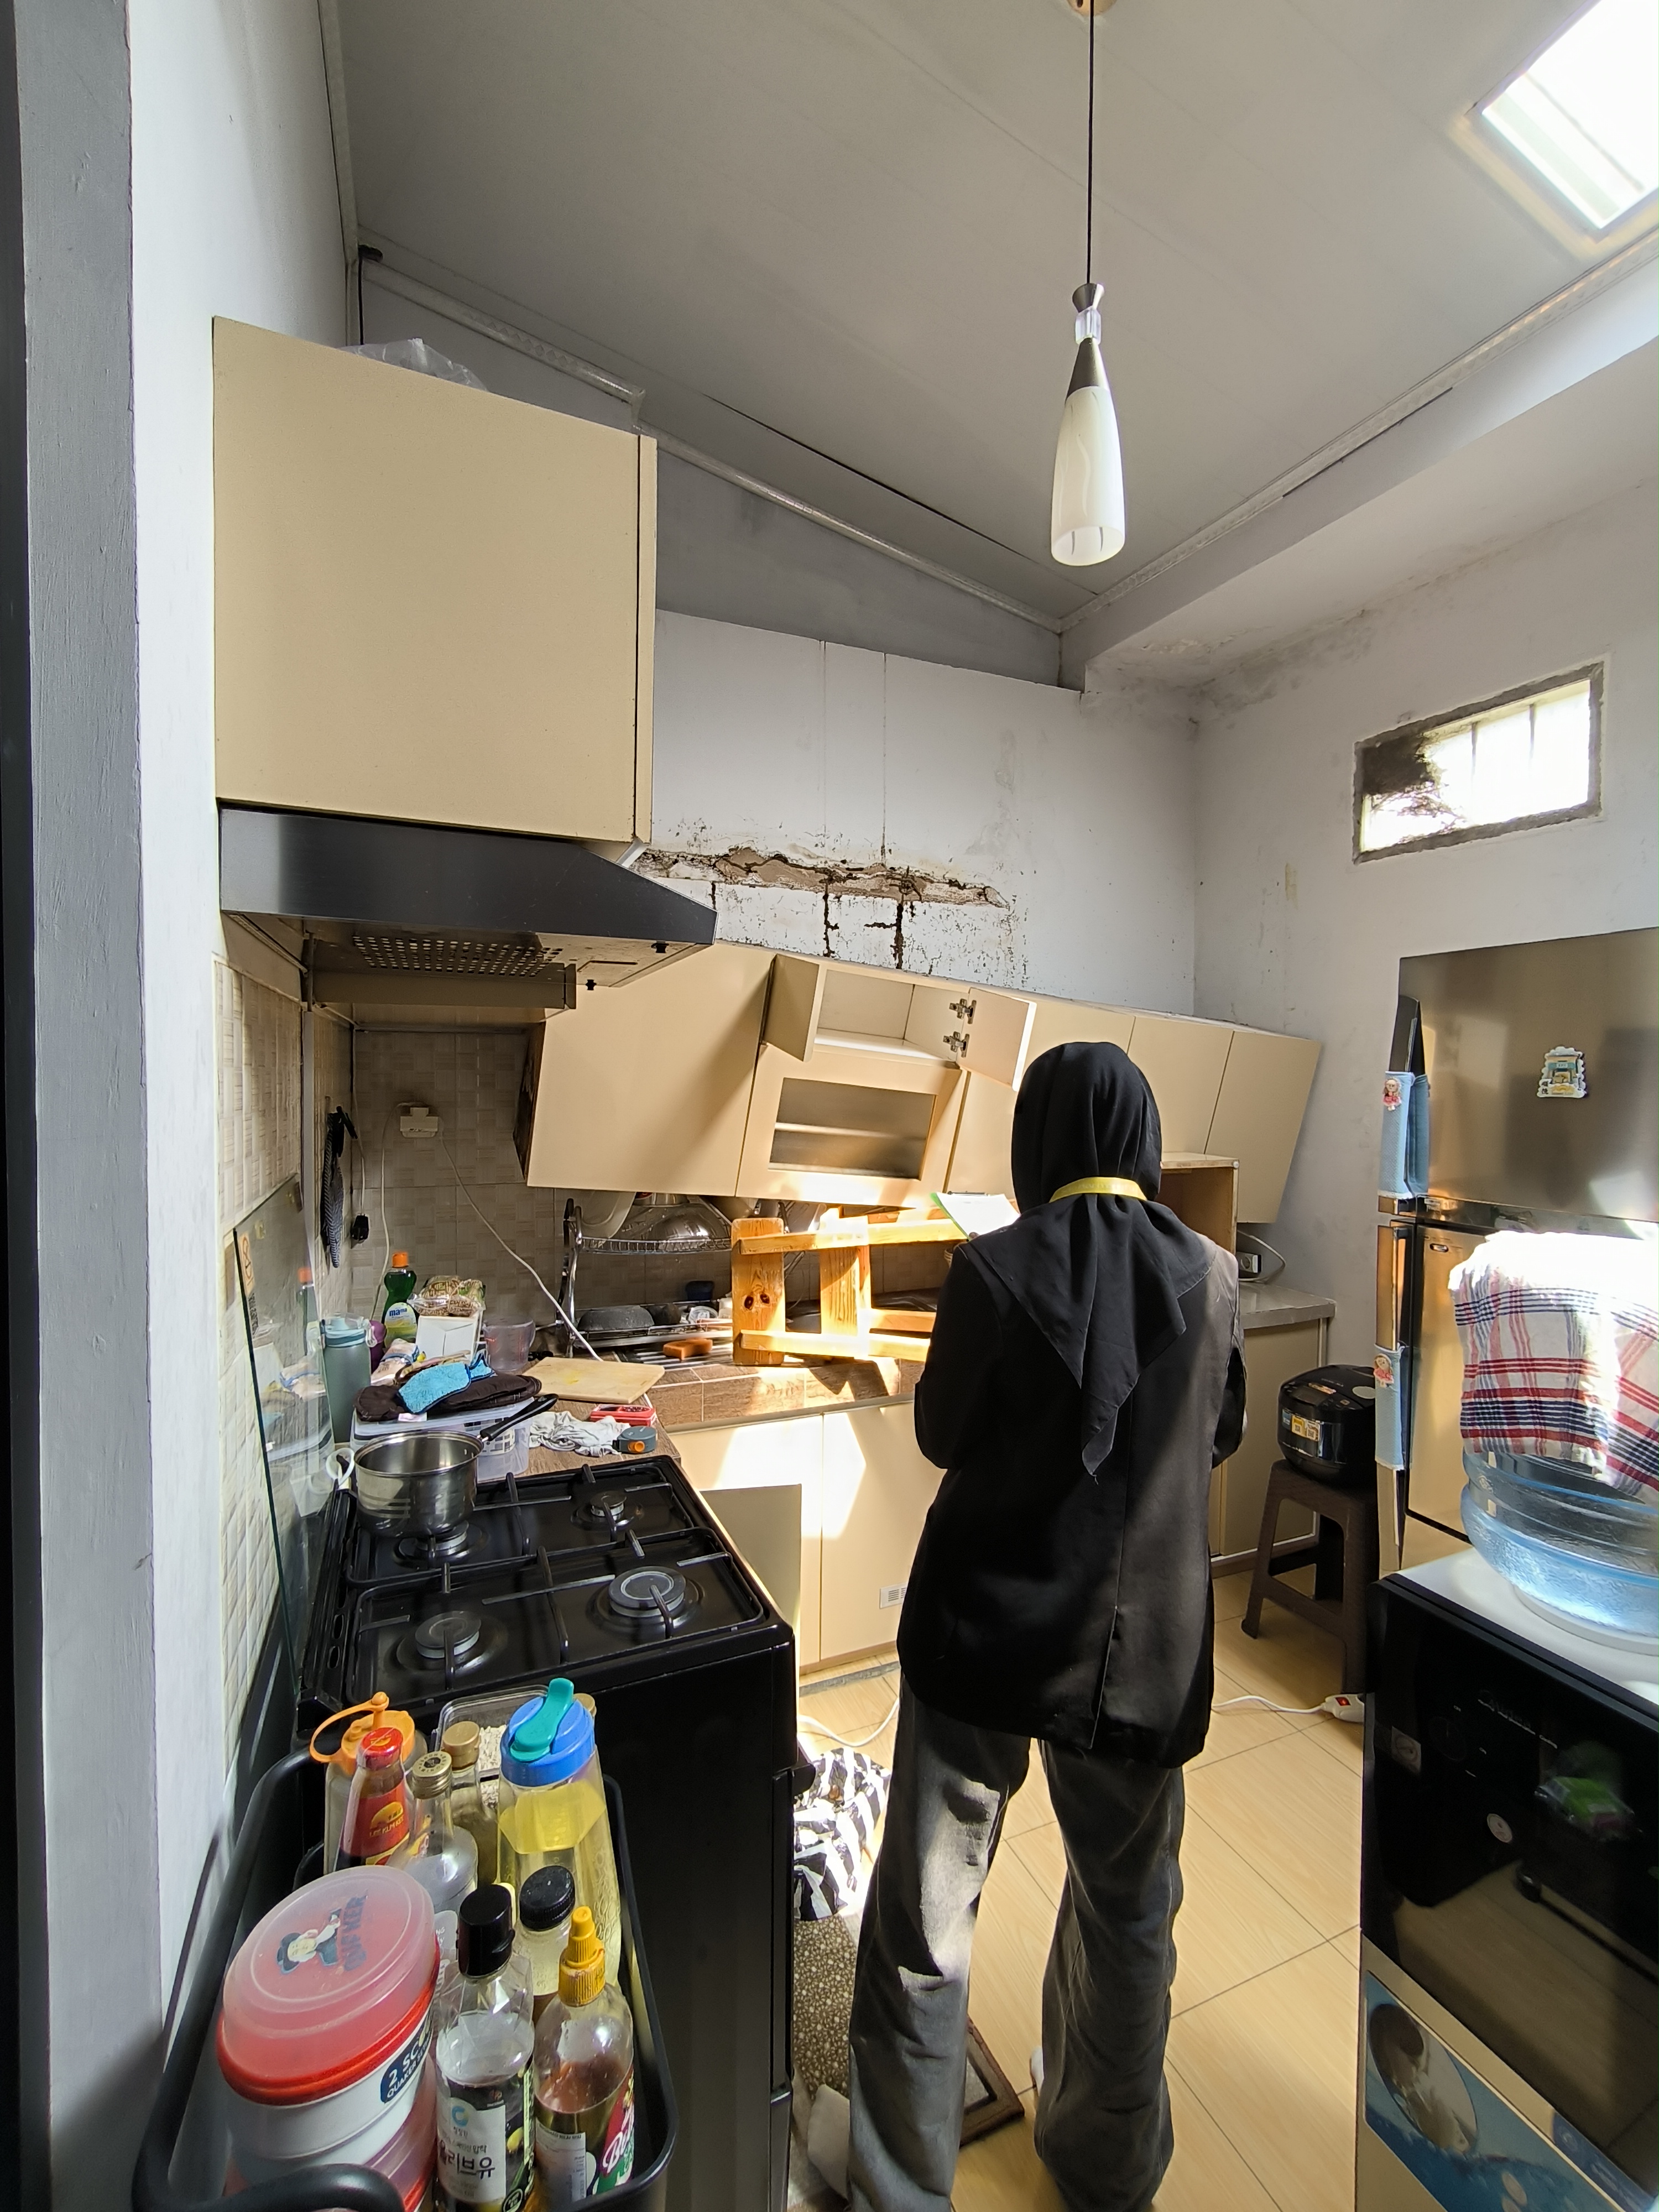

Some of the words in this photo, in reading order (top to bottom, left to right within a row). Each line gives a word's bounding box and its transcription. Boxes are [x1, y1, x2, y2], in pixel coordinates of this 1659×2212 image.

[382, 1822, 395, 1834] KUM
[387, 2060, 416, 2099] QUAKER
[389, 2069, 398, 2088] 2
